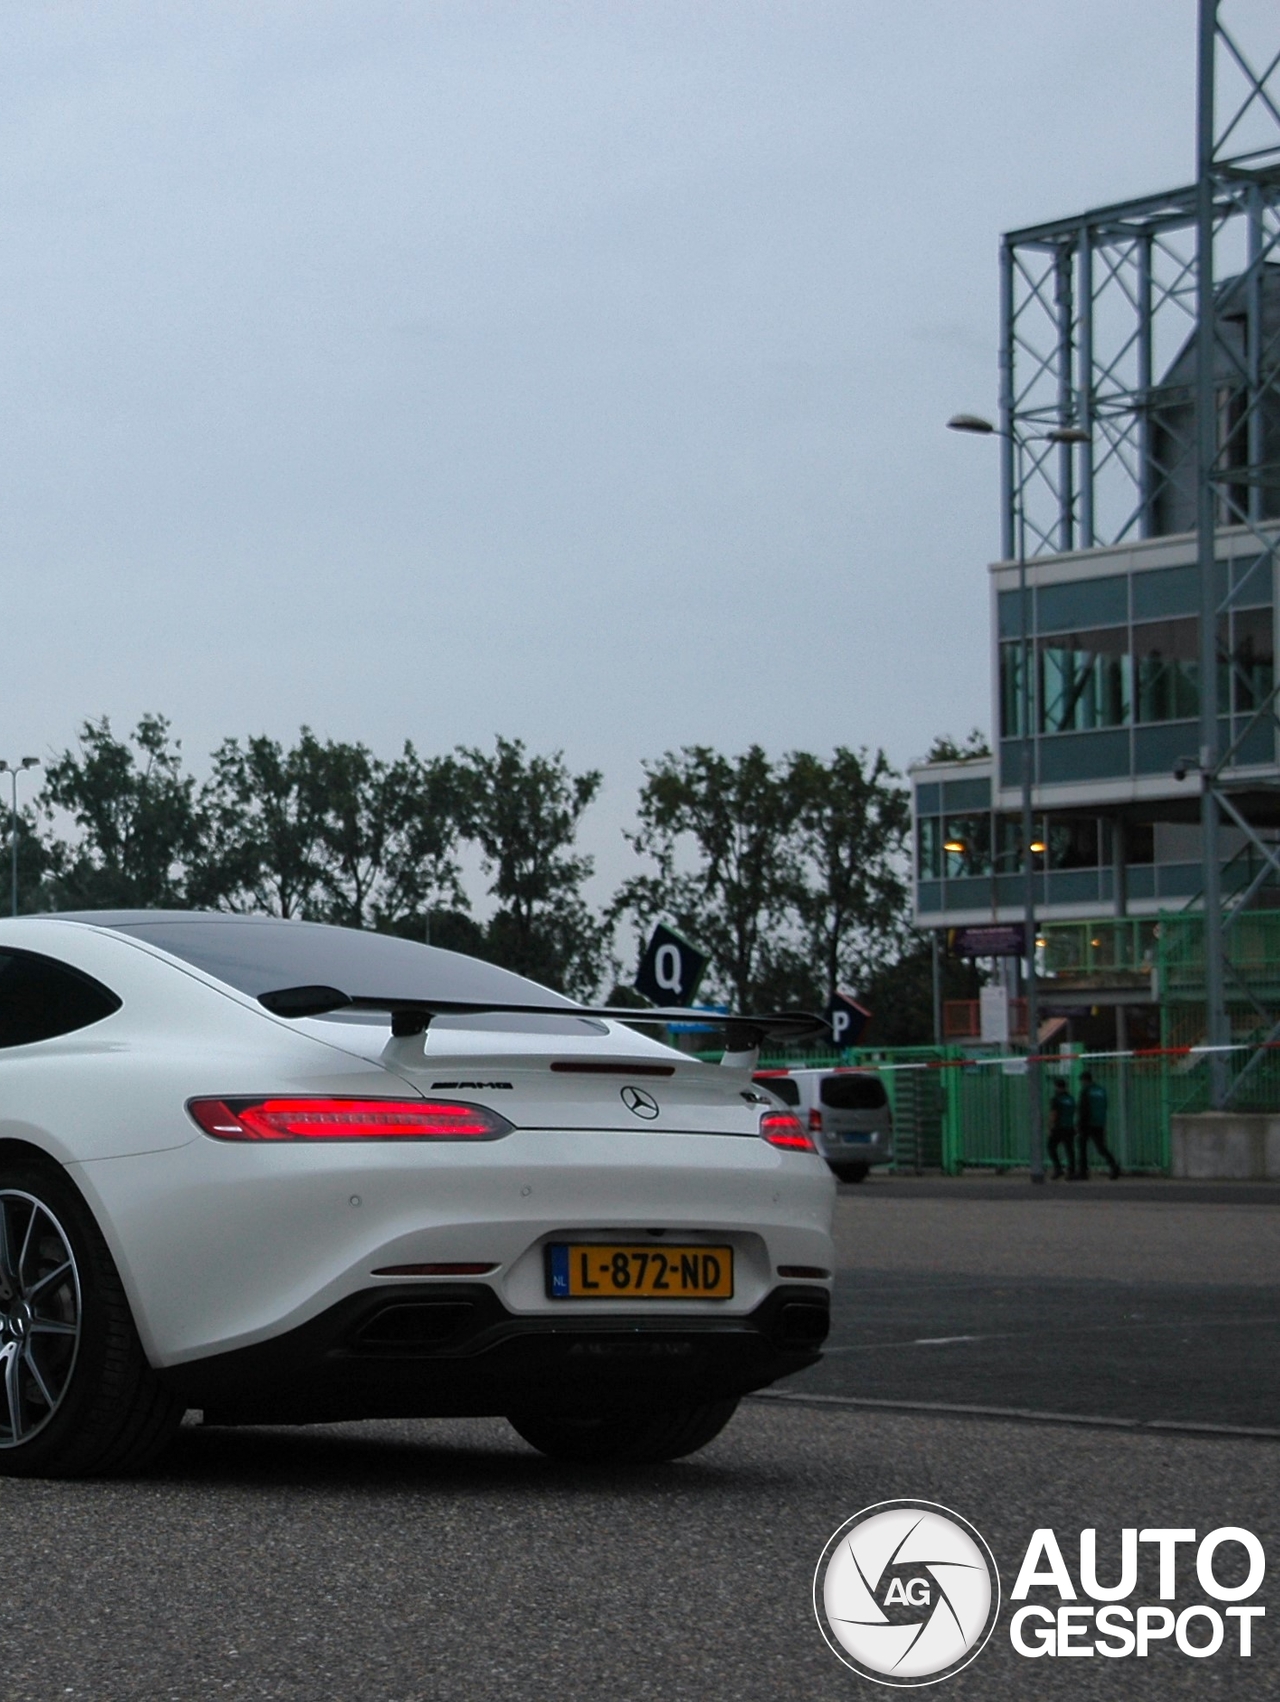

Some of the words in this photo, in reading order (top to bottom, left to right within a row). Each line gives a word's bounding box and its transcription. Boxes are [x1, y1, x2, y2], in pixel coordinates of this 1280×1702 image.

[654, 944, 682, 995] Q
[832, 1011, 850, 1042] P
[458, 1082, 513, 1090] AMG
[553, 1276, 567, 1287] NL
[581, 1252, 721, 1289] L-872-ND
